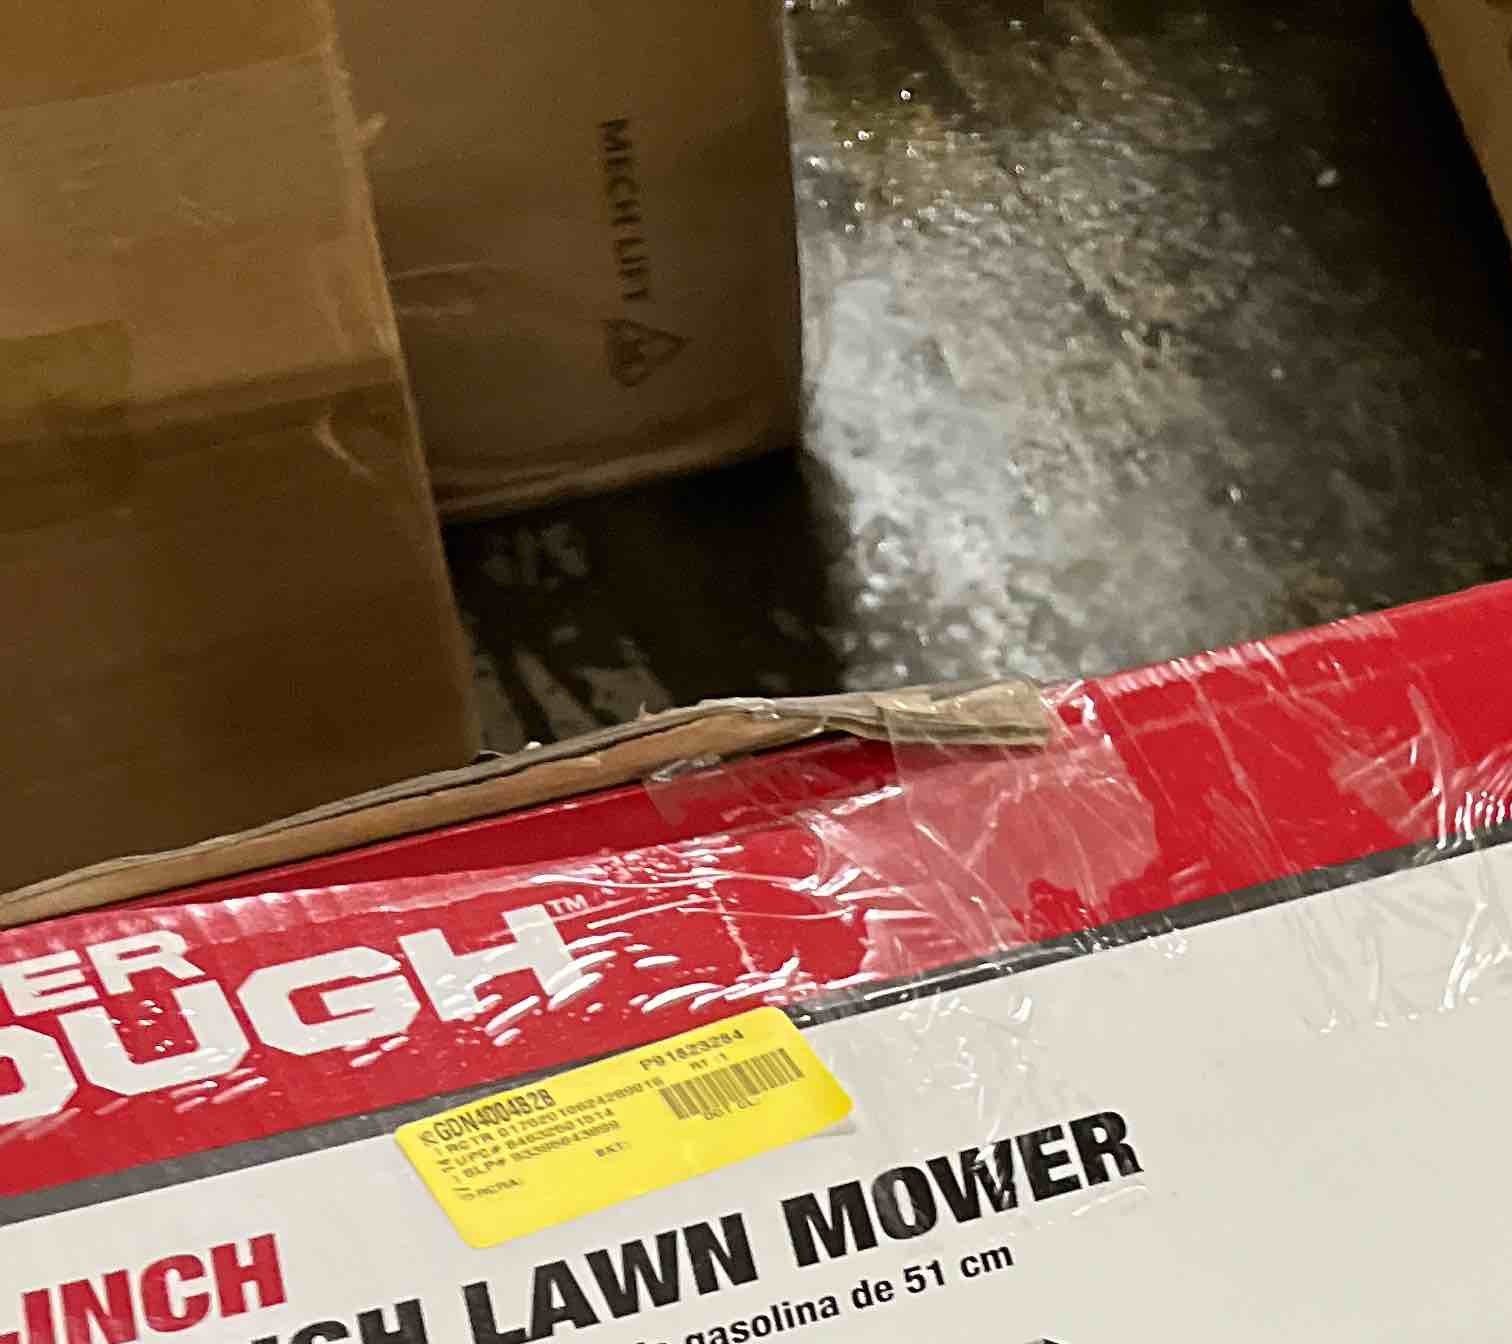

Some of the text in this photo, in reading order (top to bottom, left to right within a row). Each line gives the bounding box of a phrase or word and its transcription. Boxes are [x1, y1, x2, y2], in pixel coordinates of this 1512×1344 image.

[779, 1110, 1145, 1269] MOWER
[850, 1275, 895, 1310] de
[904, 1259, 948, 1295] 51
[959, 1244, 1016, 1279] cm
